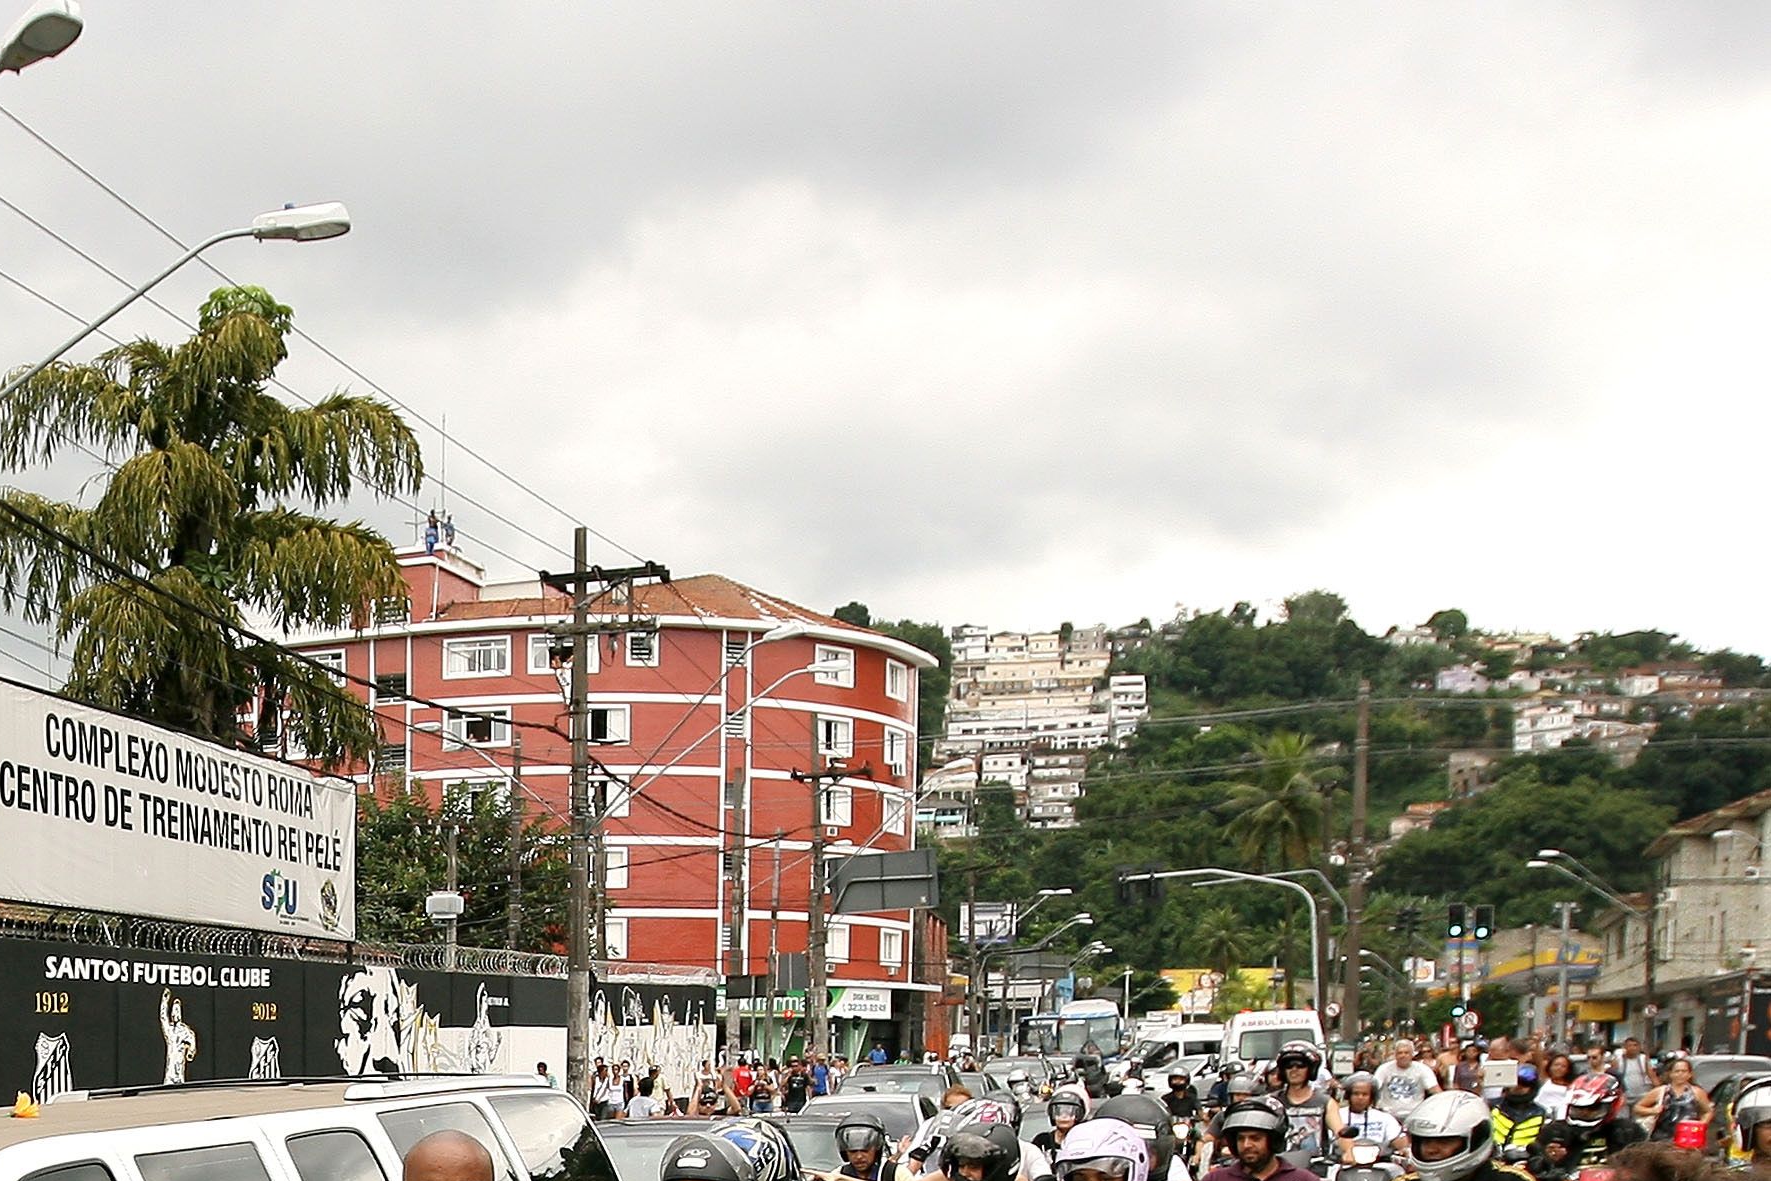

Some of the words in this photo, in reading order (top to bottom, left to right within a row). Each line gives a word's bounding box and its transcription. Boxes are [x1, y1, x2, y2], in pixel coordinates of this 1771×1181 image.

[45, 712, 169, 784] COMPLEXO
[177, 747, 262, 807] MODESTO
[267, 773, 314, 820] ROMA
[0, 760, 97, 824] CENTRO
[104, 784, 133, 831] DE
[139, 792, 273, 858] TREINAMENTO
[278, 824, 302, 864] REI
[305, 828, 342, 872] PELÉ
[44, 955, 129, 983] SANTOS
[132, 962, 218, 987] FUTEBOL
[220, 967, 271, 988] CLUBE
[35, 992, 70, 1014] 1912
[252, 1002, 278, 1021] 2012
